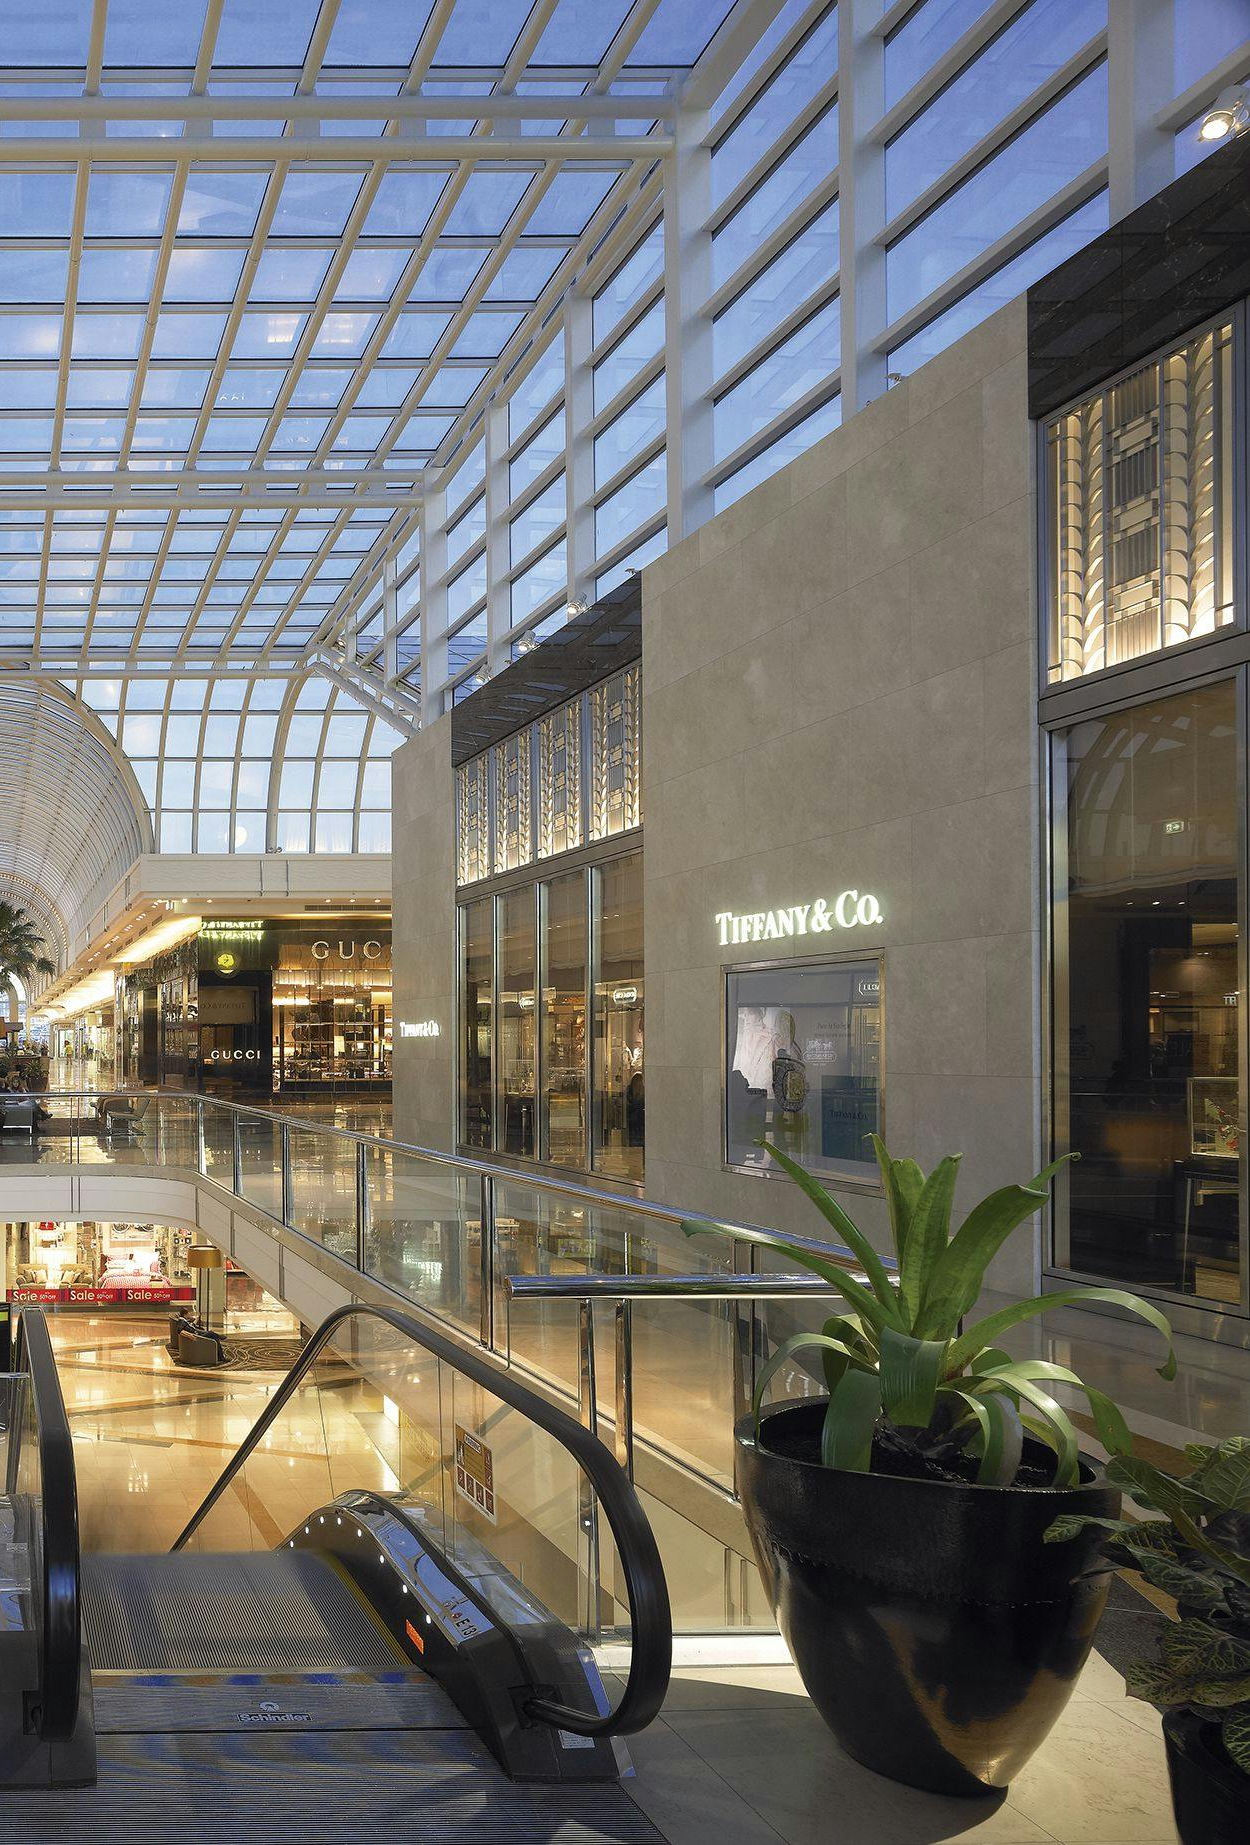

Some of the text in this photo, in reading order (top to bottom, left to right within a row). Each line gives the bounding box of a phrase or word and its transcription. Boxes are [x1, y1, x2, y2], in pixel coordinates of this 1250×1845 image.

[311, 940, 393, 960] GUC
[210, 1050, 262, 1060] GUCCI
[13, 1291, 37, 1301] Sale
[70, 1290, 95, 1300] Sale
[127, 1290, 152, 1300] Sale
[239, 1713, 310, 1721] Schindler
